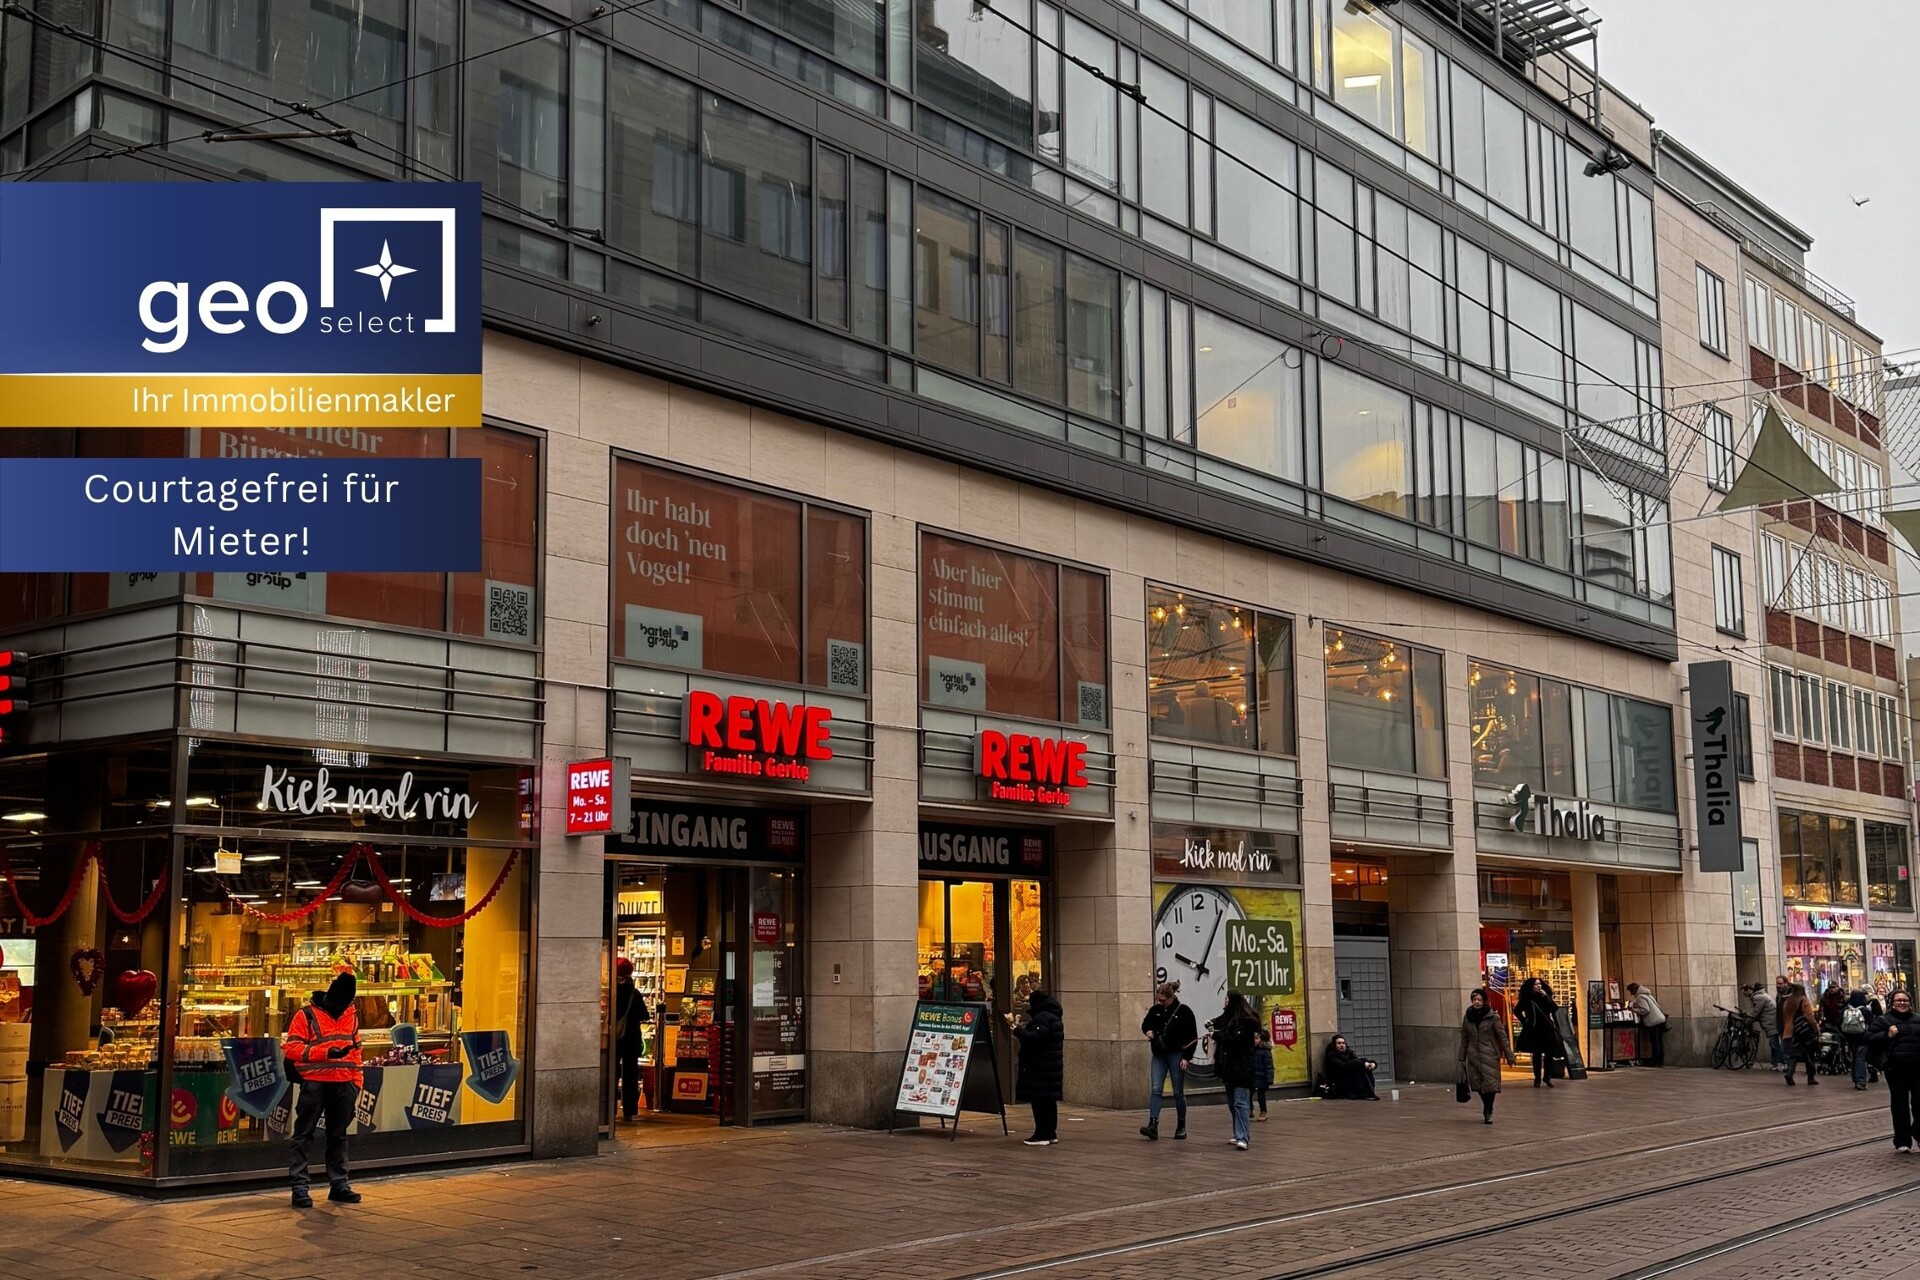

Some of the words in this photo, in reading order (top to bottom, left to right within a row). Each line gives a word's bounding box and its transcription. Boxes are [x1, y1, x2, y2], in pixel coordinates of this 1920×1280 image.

[626, 488, 659, 516] Ihr
[665, 496, 712, 529] habt
[626, 521, 679, 552] doch
[626, 551, 691, 587] Vogel!
[929, 557, 968, 583] Aber
[971, 565, 1002, 591] hier
[245, 573, 292, 590] group
[929, 586, 985, 614] stimmt
[639, 623, 673, 639] bartel
[929, 611, 987, 642] einfach
[989, 623, 1030, 648] alles!
[647, 636, 679, 650] group
[939, 671, 964, 684] bartel
[945, 681, 969, 695] group
[689, 690, 833, 760] REWE
[705, 751, 762, 777] Familie
[765, 757, 811, 781] Gerke
[982, 730, 1088, 787] REWE
[570, 769, 610, 790] REWE
[1703, 734, 1732, 826] Thalia
[261, 765, 340, 815] Kiek
[347, 771, 424, 820] mol
[424, 786, 479, 820] rin
[573, 796, 587, 807] Mo.
[595, 795, 607, 806] Sa.
[993, 781, 1035, 802] Familie
[570, 813, 576, 824] 7
[583, 813, 594, 823] 21
[595, 812, 609, 823] Uhr
[771, 819, 795, 831] REWE
[1533, 795, 1605, 842] Thalia
[1023, 838, 1043, 848] REWE
[1180, 838, 1215, 870] Kiek
[1217, 840, 1248, 872] mol
[1248, 850, 1272, 872] rin
[1191, 894, 1205, 911] 12
[758, 918, 777, 926] REWE
[1174, 907, 1183, 924] 11
[1162, 932, 1173, 949] 10
[1265, 960, 1289, 987] Uhr
[920, 1011, 942, 1022] REWE
[942, 1013, 962, 1024] Bonus
[1275, 1015, 1294, 1025] REWE
[240, 1055, 272, 1080] TIEF
[477, 1048, 504, 1070] TIEF
[246, 1073, 274, 1091] PREIS
[484, 1063, 506, 1081] PREIS
[64, 1088, 84, 1116] TIEF
[113, 1089, 143, 1113] TIE
[356, 1089, 374, 1111] IEF
[418, 1083, 453, 1108] TIEF
[61, 1110, 78, 1131] PREIS
[110, 1111, 141, 1129] PREIS
[416, 1107, 443, 1121] PREIS
[217, 1128, 238, 1144] REWE
